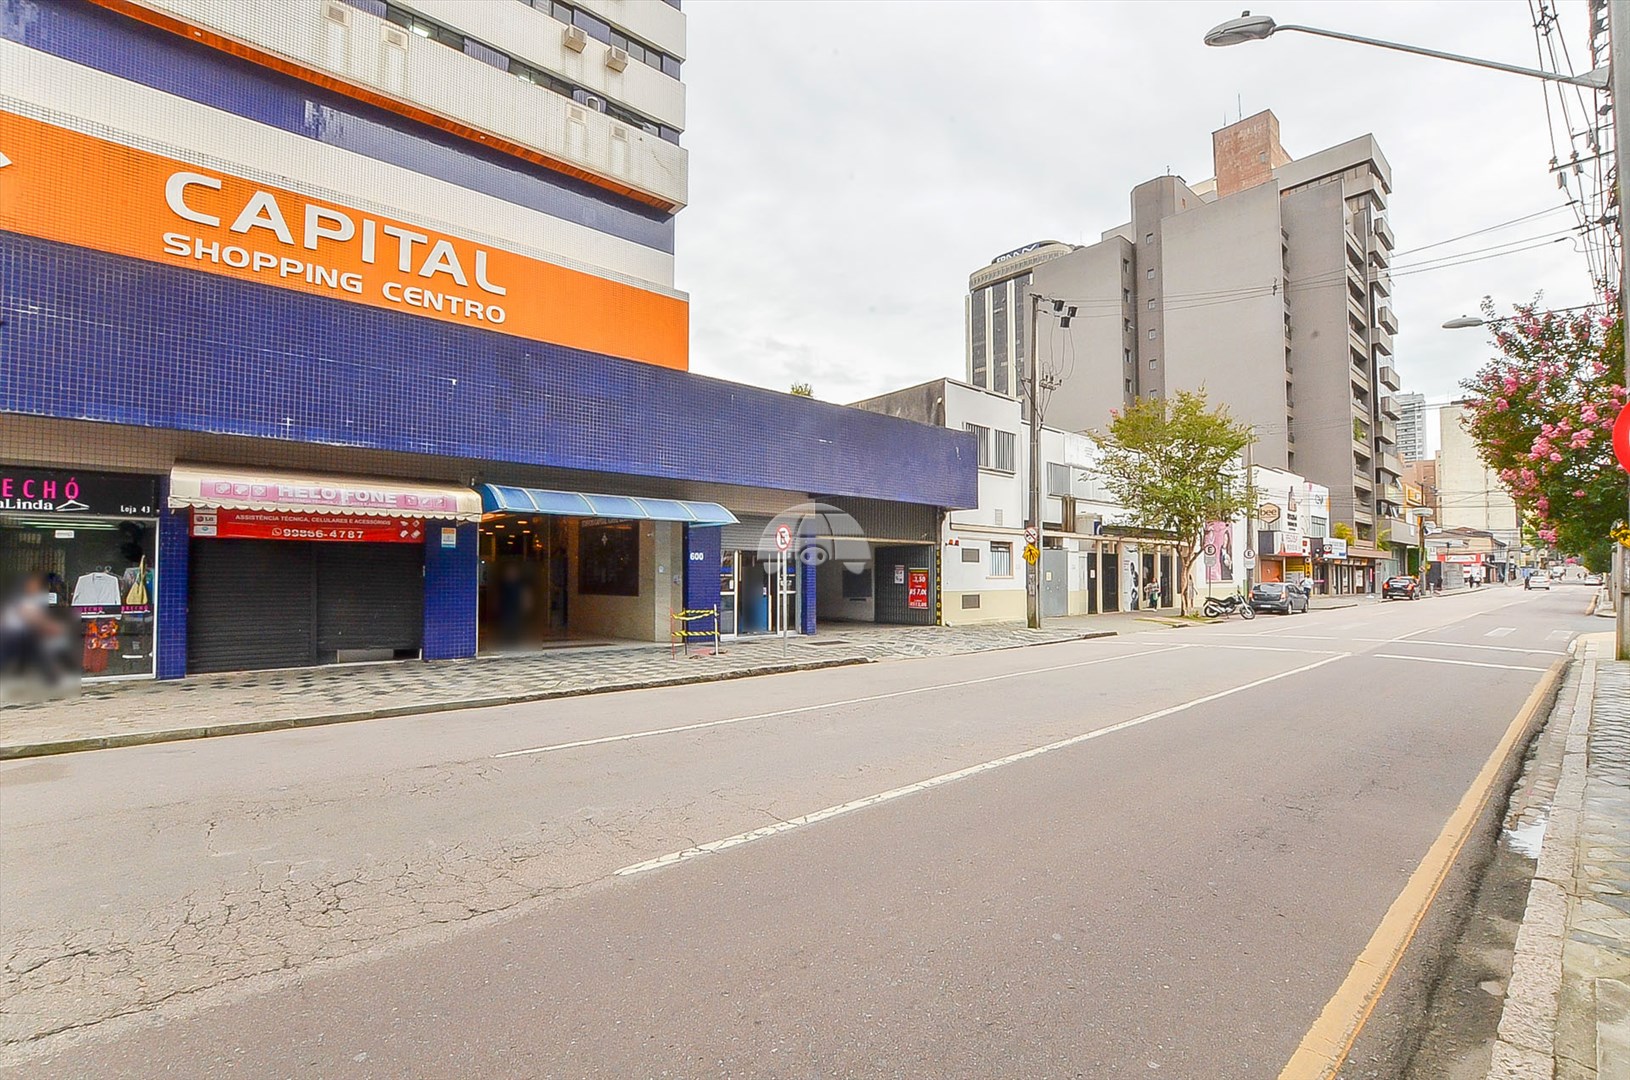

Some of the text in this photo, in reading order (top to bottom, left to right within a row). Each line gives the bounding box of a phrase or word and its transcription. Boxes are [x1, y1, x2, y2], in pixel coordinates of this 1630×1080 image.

[165, 172, 507, 296] CAPITAL
[162, 231, 506, 324] SHOPPING CENTRO
[235, 513, 279, 522] ASSISTÊNCIA
[354, 518, 391, 526] ACESSÓRIOS
[690, 552, 704, 561] 600
